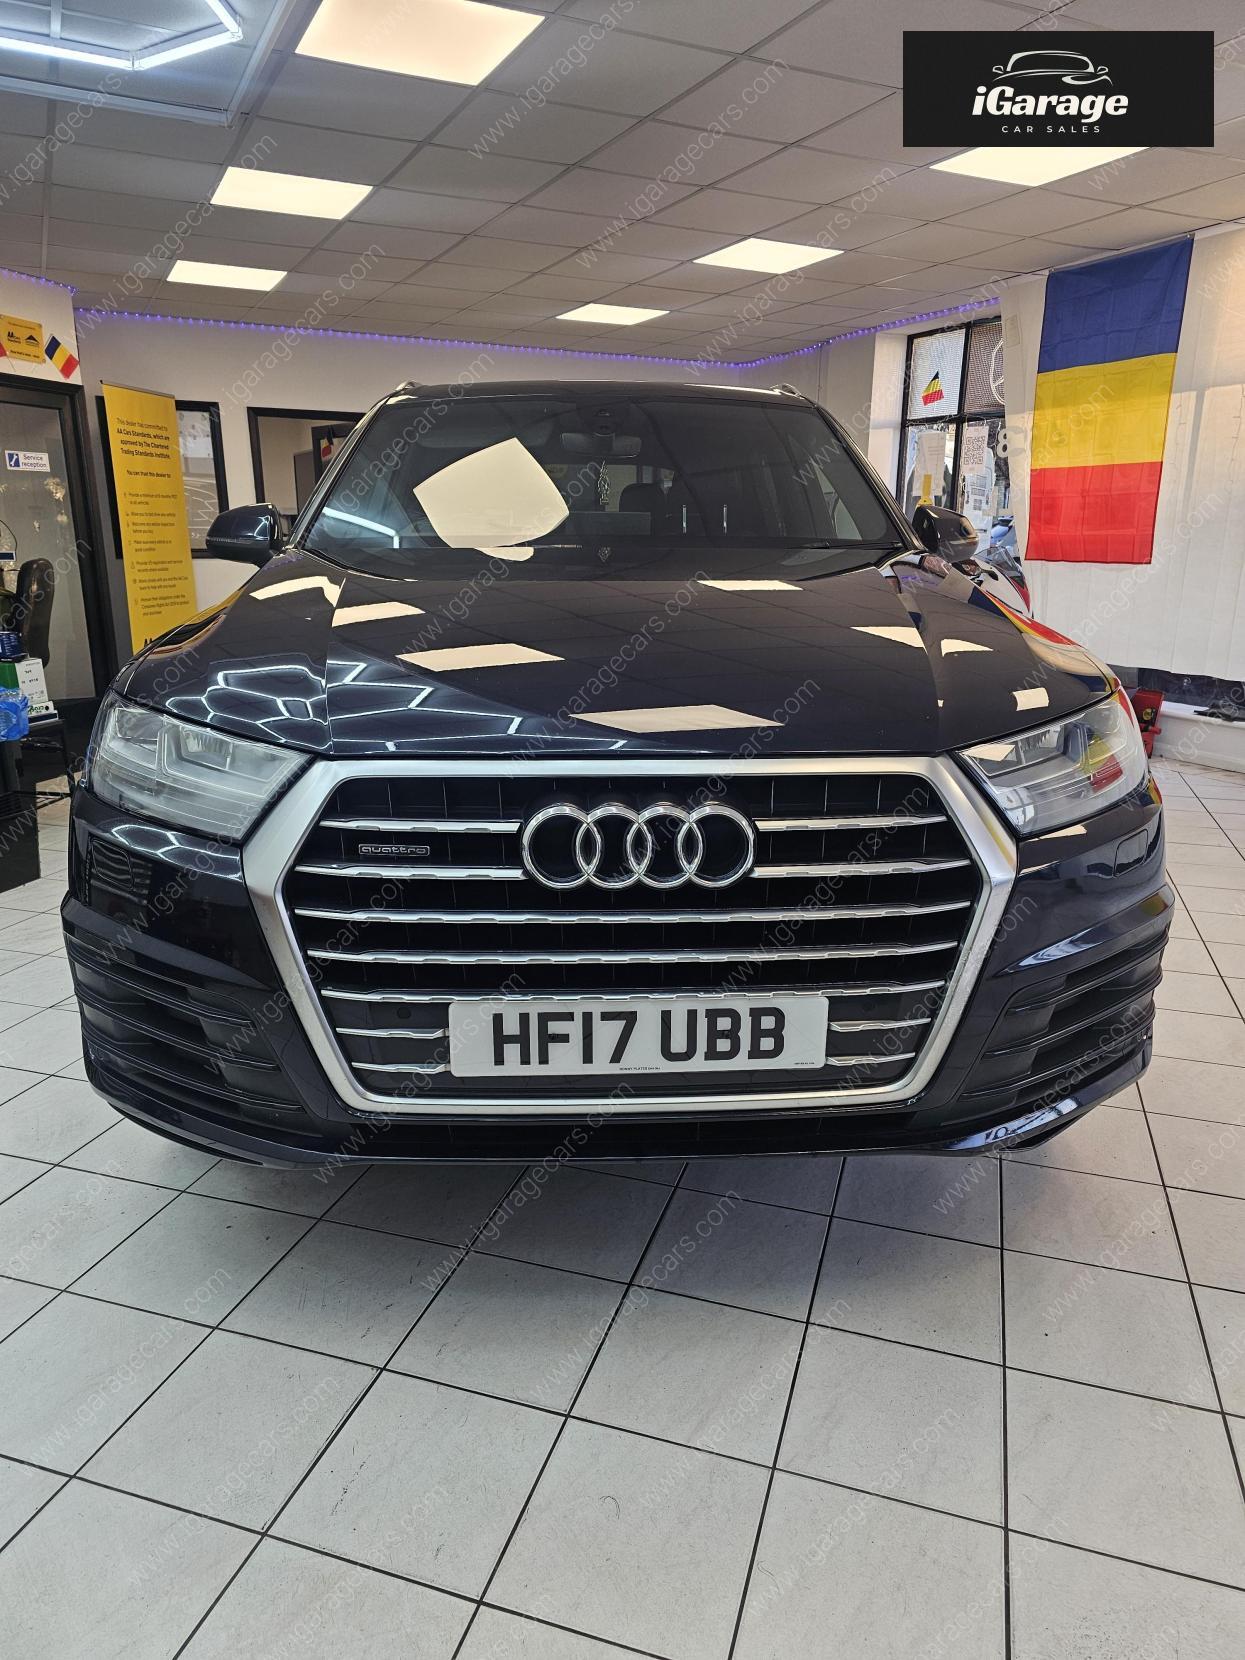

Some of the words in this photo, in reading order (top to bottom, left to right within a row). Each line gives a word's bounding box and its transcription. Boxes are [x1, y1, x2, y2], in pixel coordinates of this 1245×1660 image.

[361, 846, 426, 854] quattro
[492, 1010, 638, 1066] HF17
[660, 1006, 786, 1063] UBB
